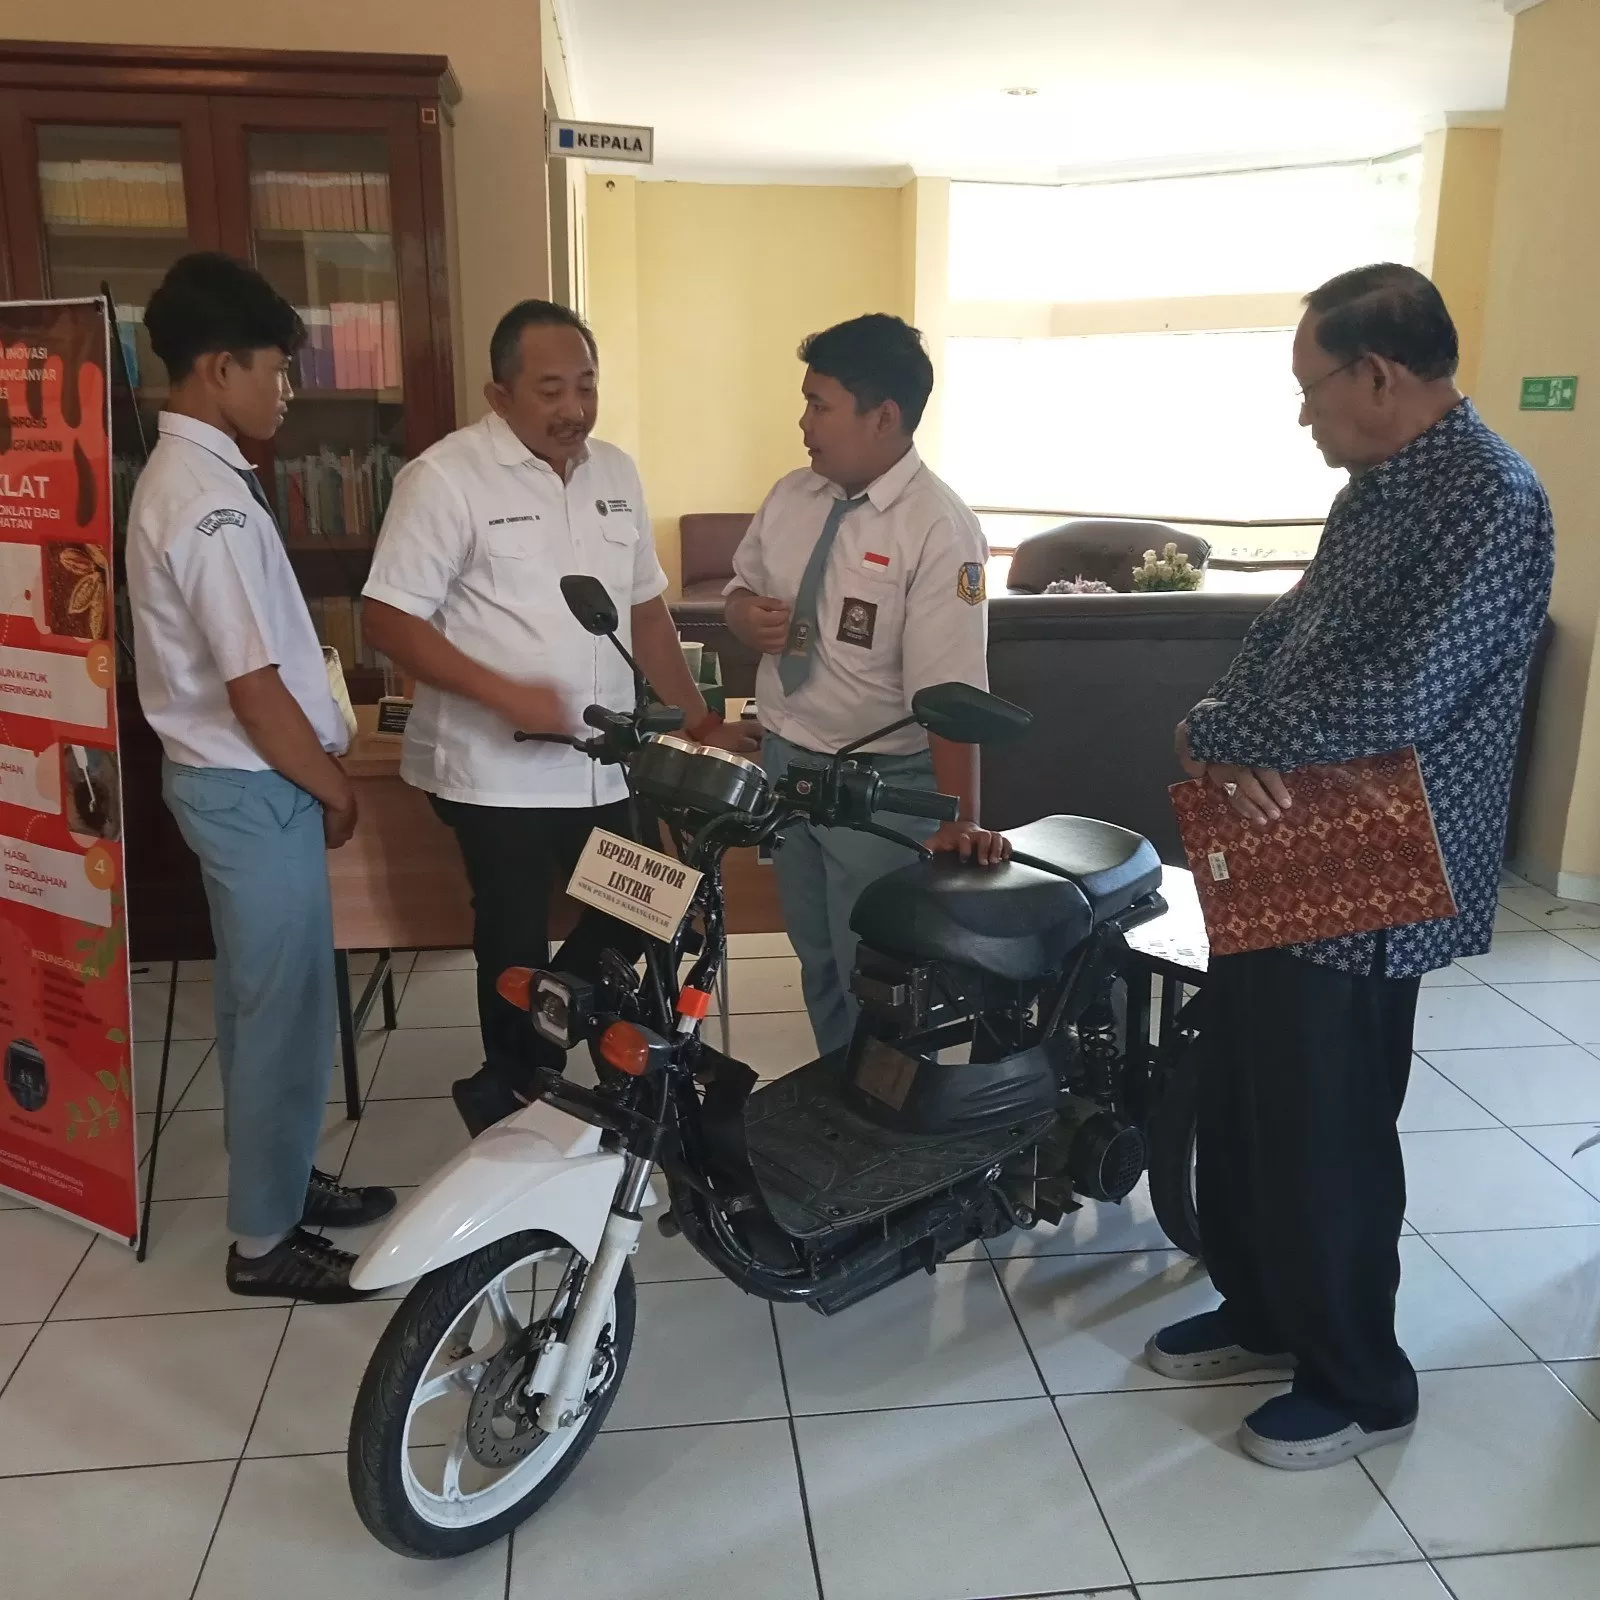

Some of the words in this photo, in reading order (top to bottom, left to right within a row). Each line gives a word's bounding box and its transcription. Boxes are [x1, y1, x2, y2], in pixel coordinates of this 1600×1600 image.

[577, 133, 643, 152] KEPALA
[5, 347, 48, 360] INOVASI
[34, 507, 61, 520] BAGI
[97, 655, 109, 673] 2
[16, 671, 48, 683] KATUK
[4, 848, 30, 863] HASIL
[596, 839, 642, 871] SEPEDA
[640, 857, 687, 890] MOTOR
[4, 863, 68, 889] PENGOLAHAN
[94, 859, 106, 875] 4
[8, 879, 44, 897] DAKLAT
[607, 871, 656, 904] LISTRIK
